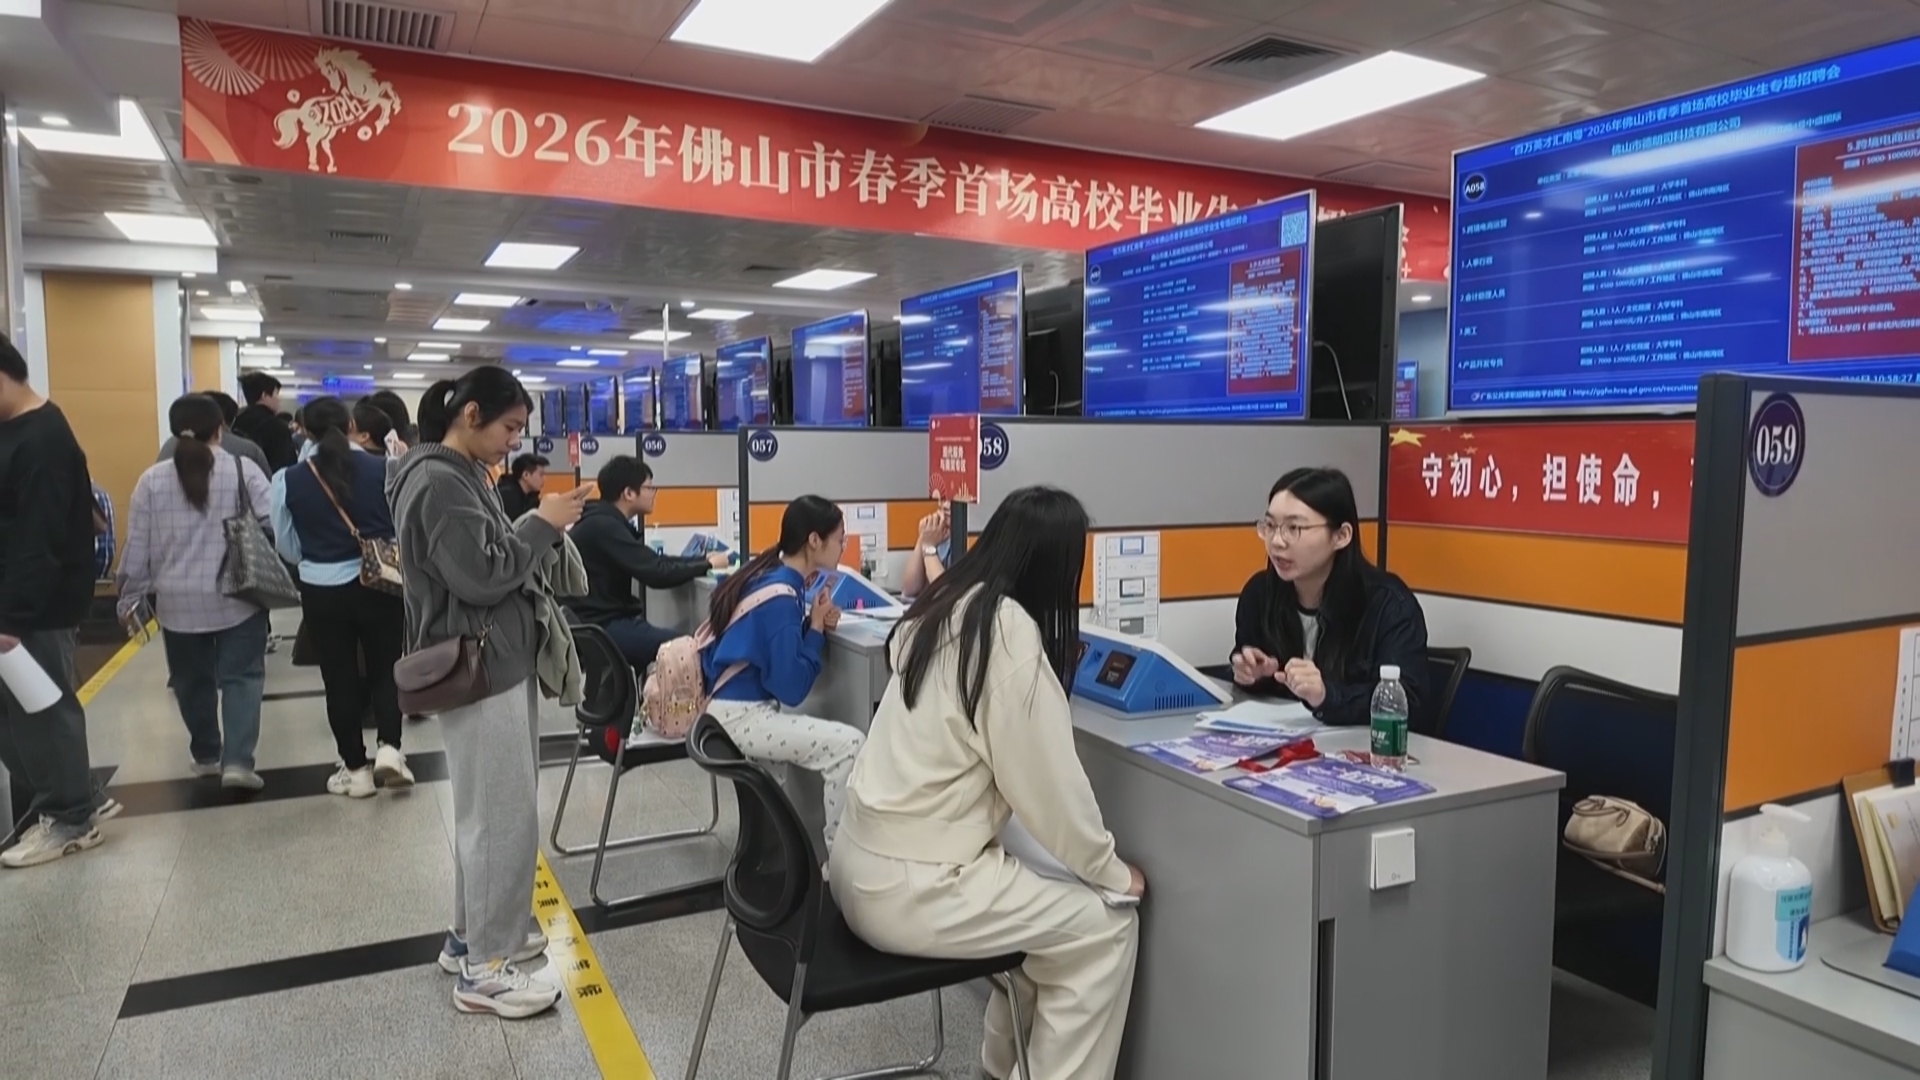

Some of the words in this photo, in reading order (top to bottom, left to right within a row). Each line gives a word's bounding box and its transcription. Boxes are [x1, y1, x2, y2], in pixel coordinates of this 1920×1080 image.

[319, 87, 365, 126] 2026
[645, 438, 663, 451] 056
[751, 438, 774, 453] 057
[980, 437, 1002, 457] 58
[1756, 424, 1797, 466] 059
[1422, 452, 1694, 509] 守初心，担使命，
